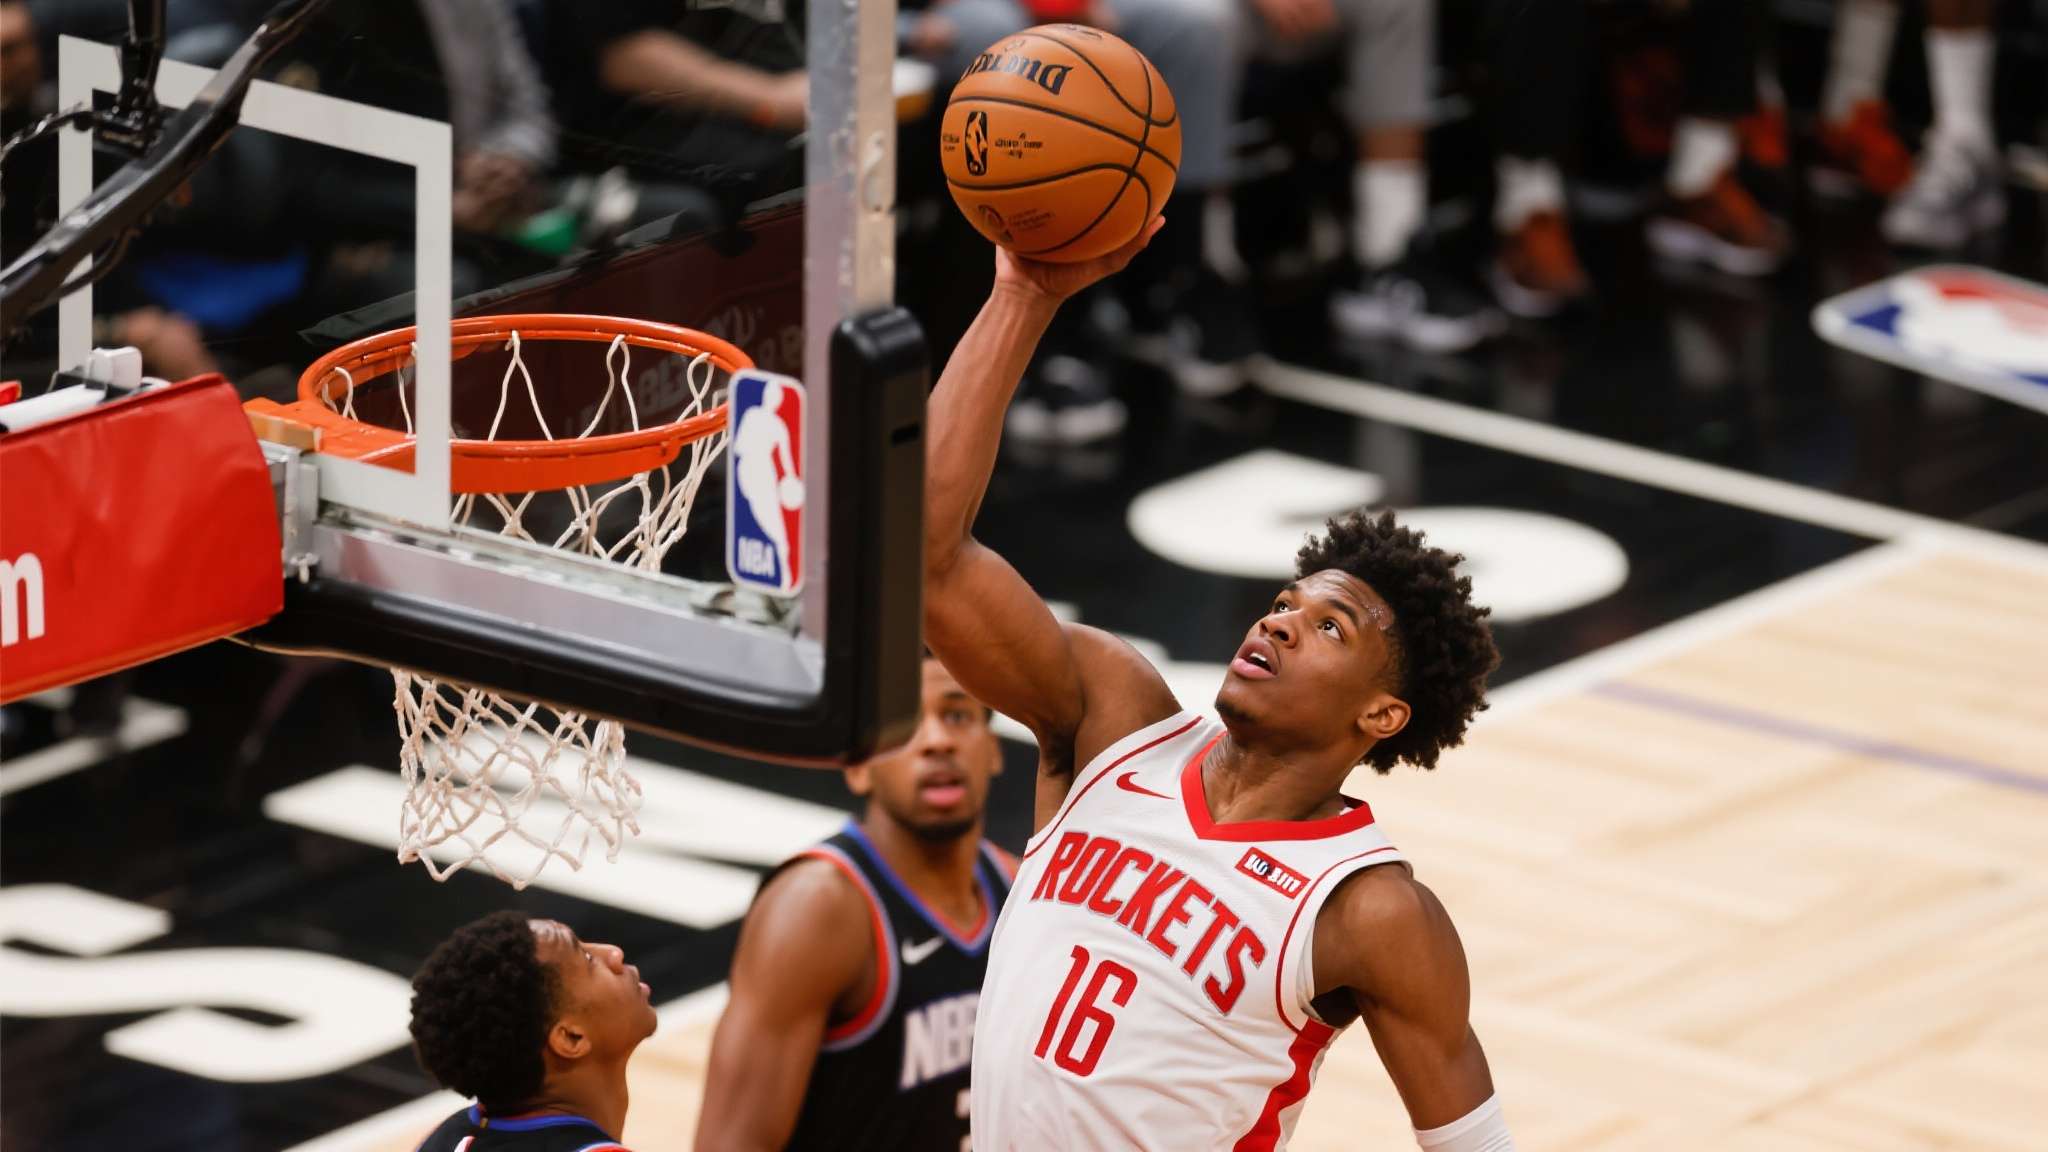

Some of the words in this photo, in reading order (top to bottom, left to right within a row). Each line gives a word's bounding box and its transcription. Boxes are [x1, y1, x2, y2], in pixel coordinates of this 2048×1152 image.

[737, 535, 776, 578] NBA
[1031, 831, 1266, 1016] ROCKETS
[1033, 944, 1139, 1078] 16
